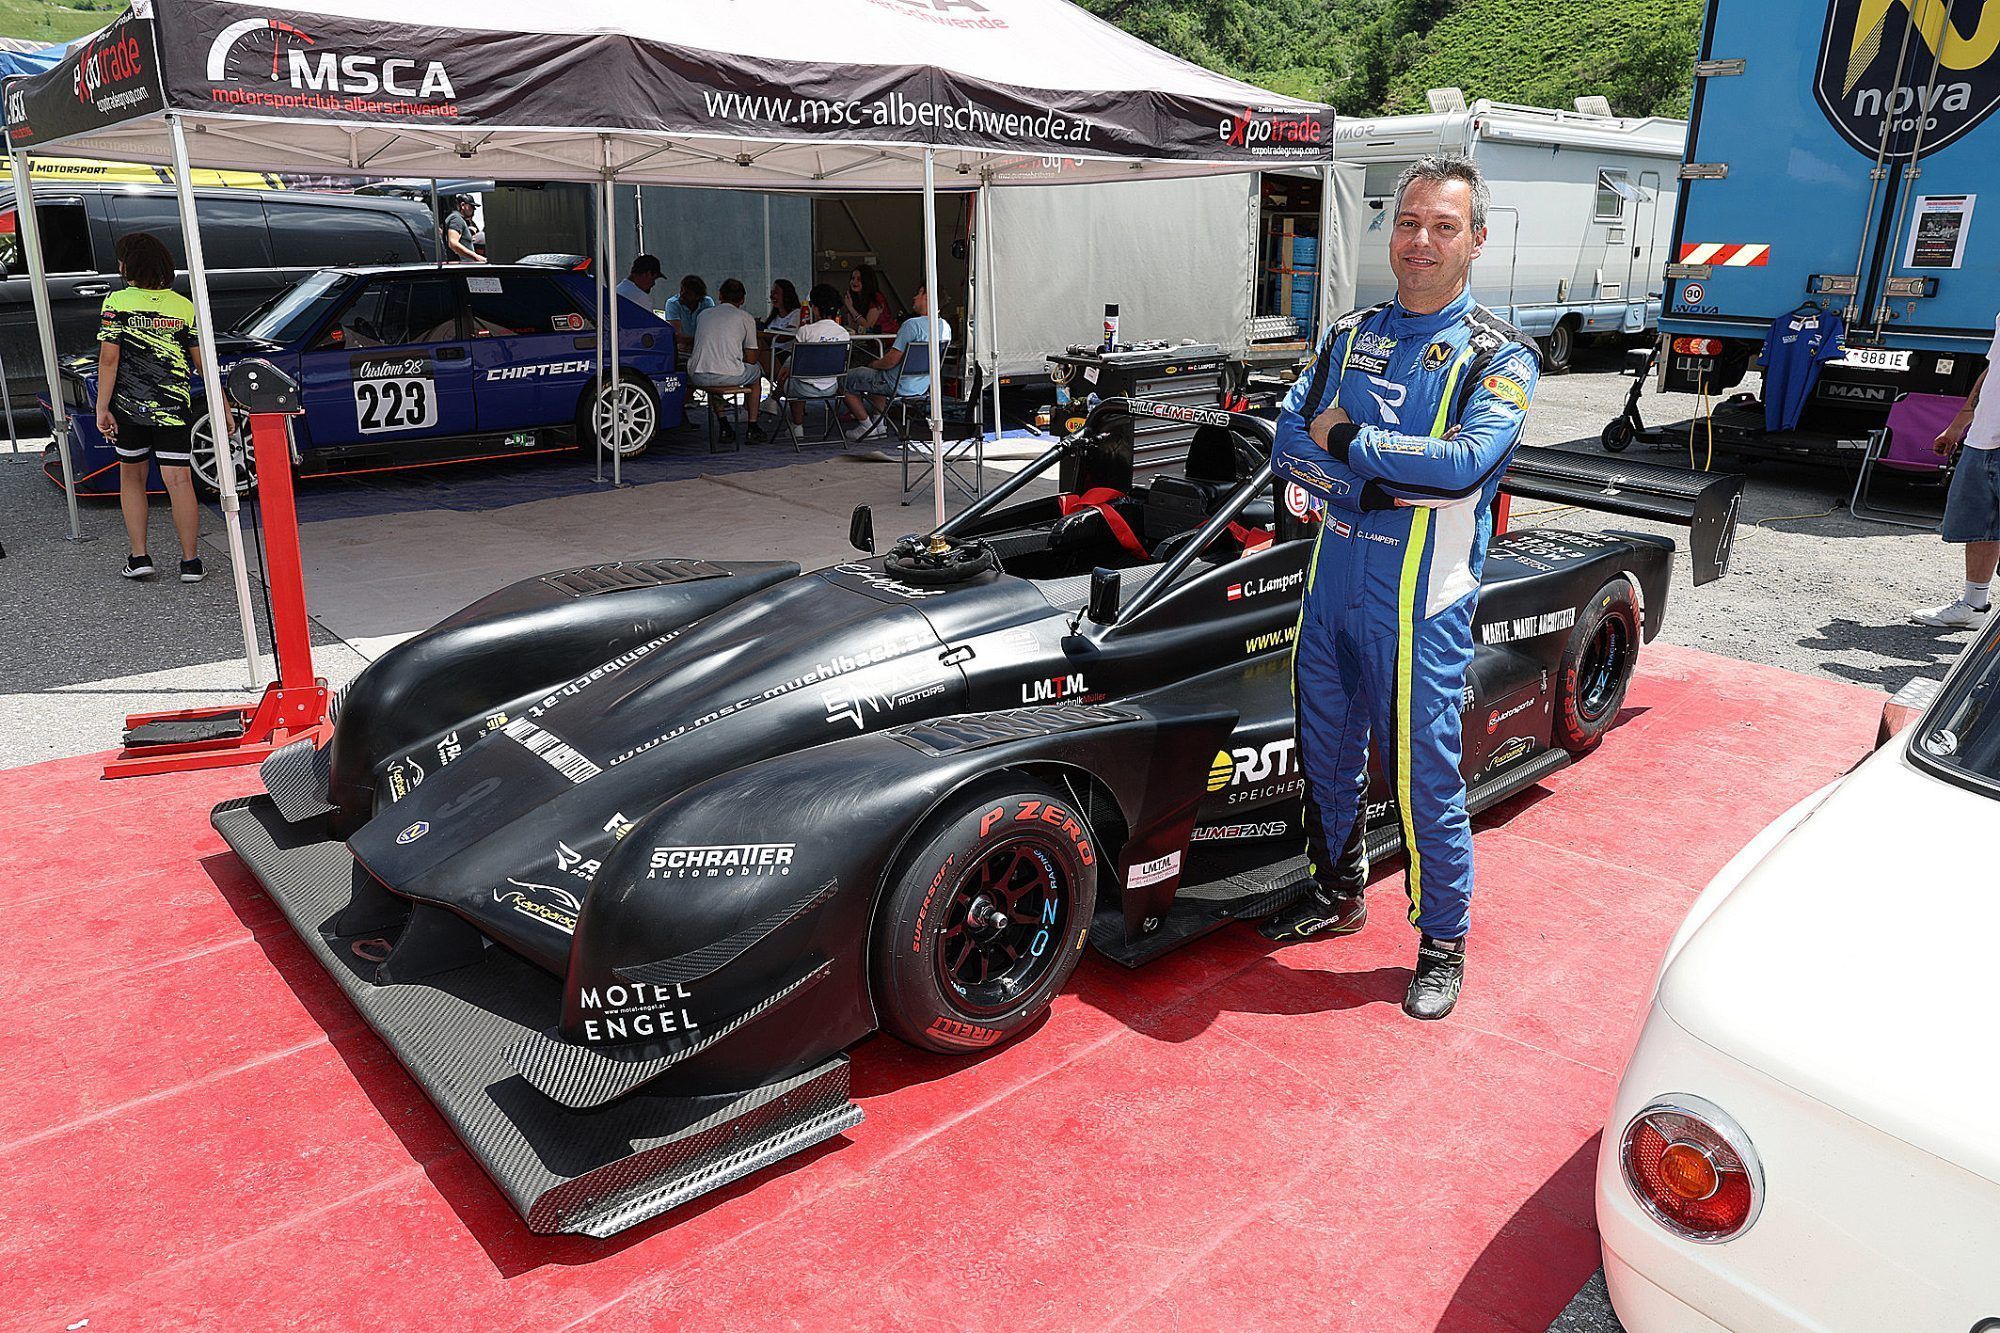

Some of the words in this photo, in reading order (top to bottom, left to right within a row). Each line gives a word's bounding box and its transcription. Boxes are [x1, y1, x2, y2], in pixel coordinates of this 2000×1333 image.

[287, 49, 456, 99] MSCA
[212, 87, 341, 112] motorsportclub
[344, 97, 459, 117] alberschwende
[1854, 82, 1972, 117] nova
[703, 91, 1092, 143] www.msc-alberschwende.at
[1878, 113, 1938, 137] proto
[1251, 146, 1320, 158] expotradegroup.com
[36, 164, 107, 174] MOTORSPORT
[1686, 290, 1701, 298] 90
[1680, 304, 1719, 314] NOVA
[360, 361, 402, 378] Custom
[404, 359, 424, 375] 28
[486, 360, 590, 381] CHIPTECH
[357, 381, 426, 430] 223
[1828, 385, 1885, 399] MAN
[1127, 400, 1230, 427] HILLCLIMBFANS
[1364, 533, 1400, 546] LAMPERT
[1244, 581, 1257, 597] C.
[1258, 569, 1304, 594] Lampert
[898, 684, 945, 706] MOTORS
[1022, 673, 1089, 703] LMTM
[1565, 668, 1585, 742] ZERO
[979, 806, 1004, 837] P
[1014, 801, 1094, 866] ZERO
[649, 843, 796, 869] SCHRATTER
[1032, 849, 1059, 889] RACING
[646, 866, 790, 880] Automobile
[913, 853, 956, 953] SUPERSOFT
[581, 982, 692, 1009] MOTEL
[584, 1009, 698, 1041] ENGEL
[929, 1016, 1003, 1047] PIRELLI
